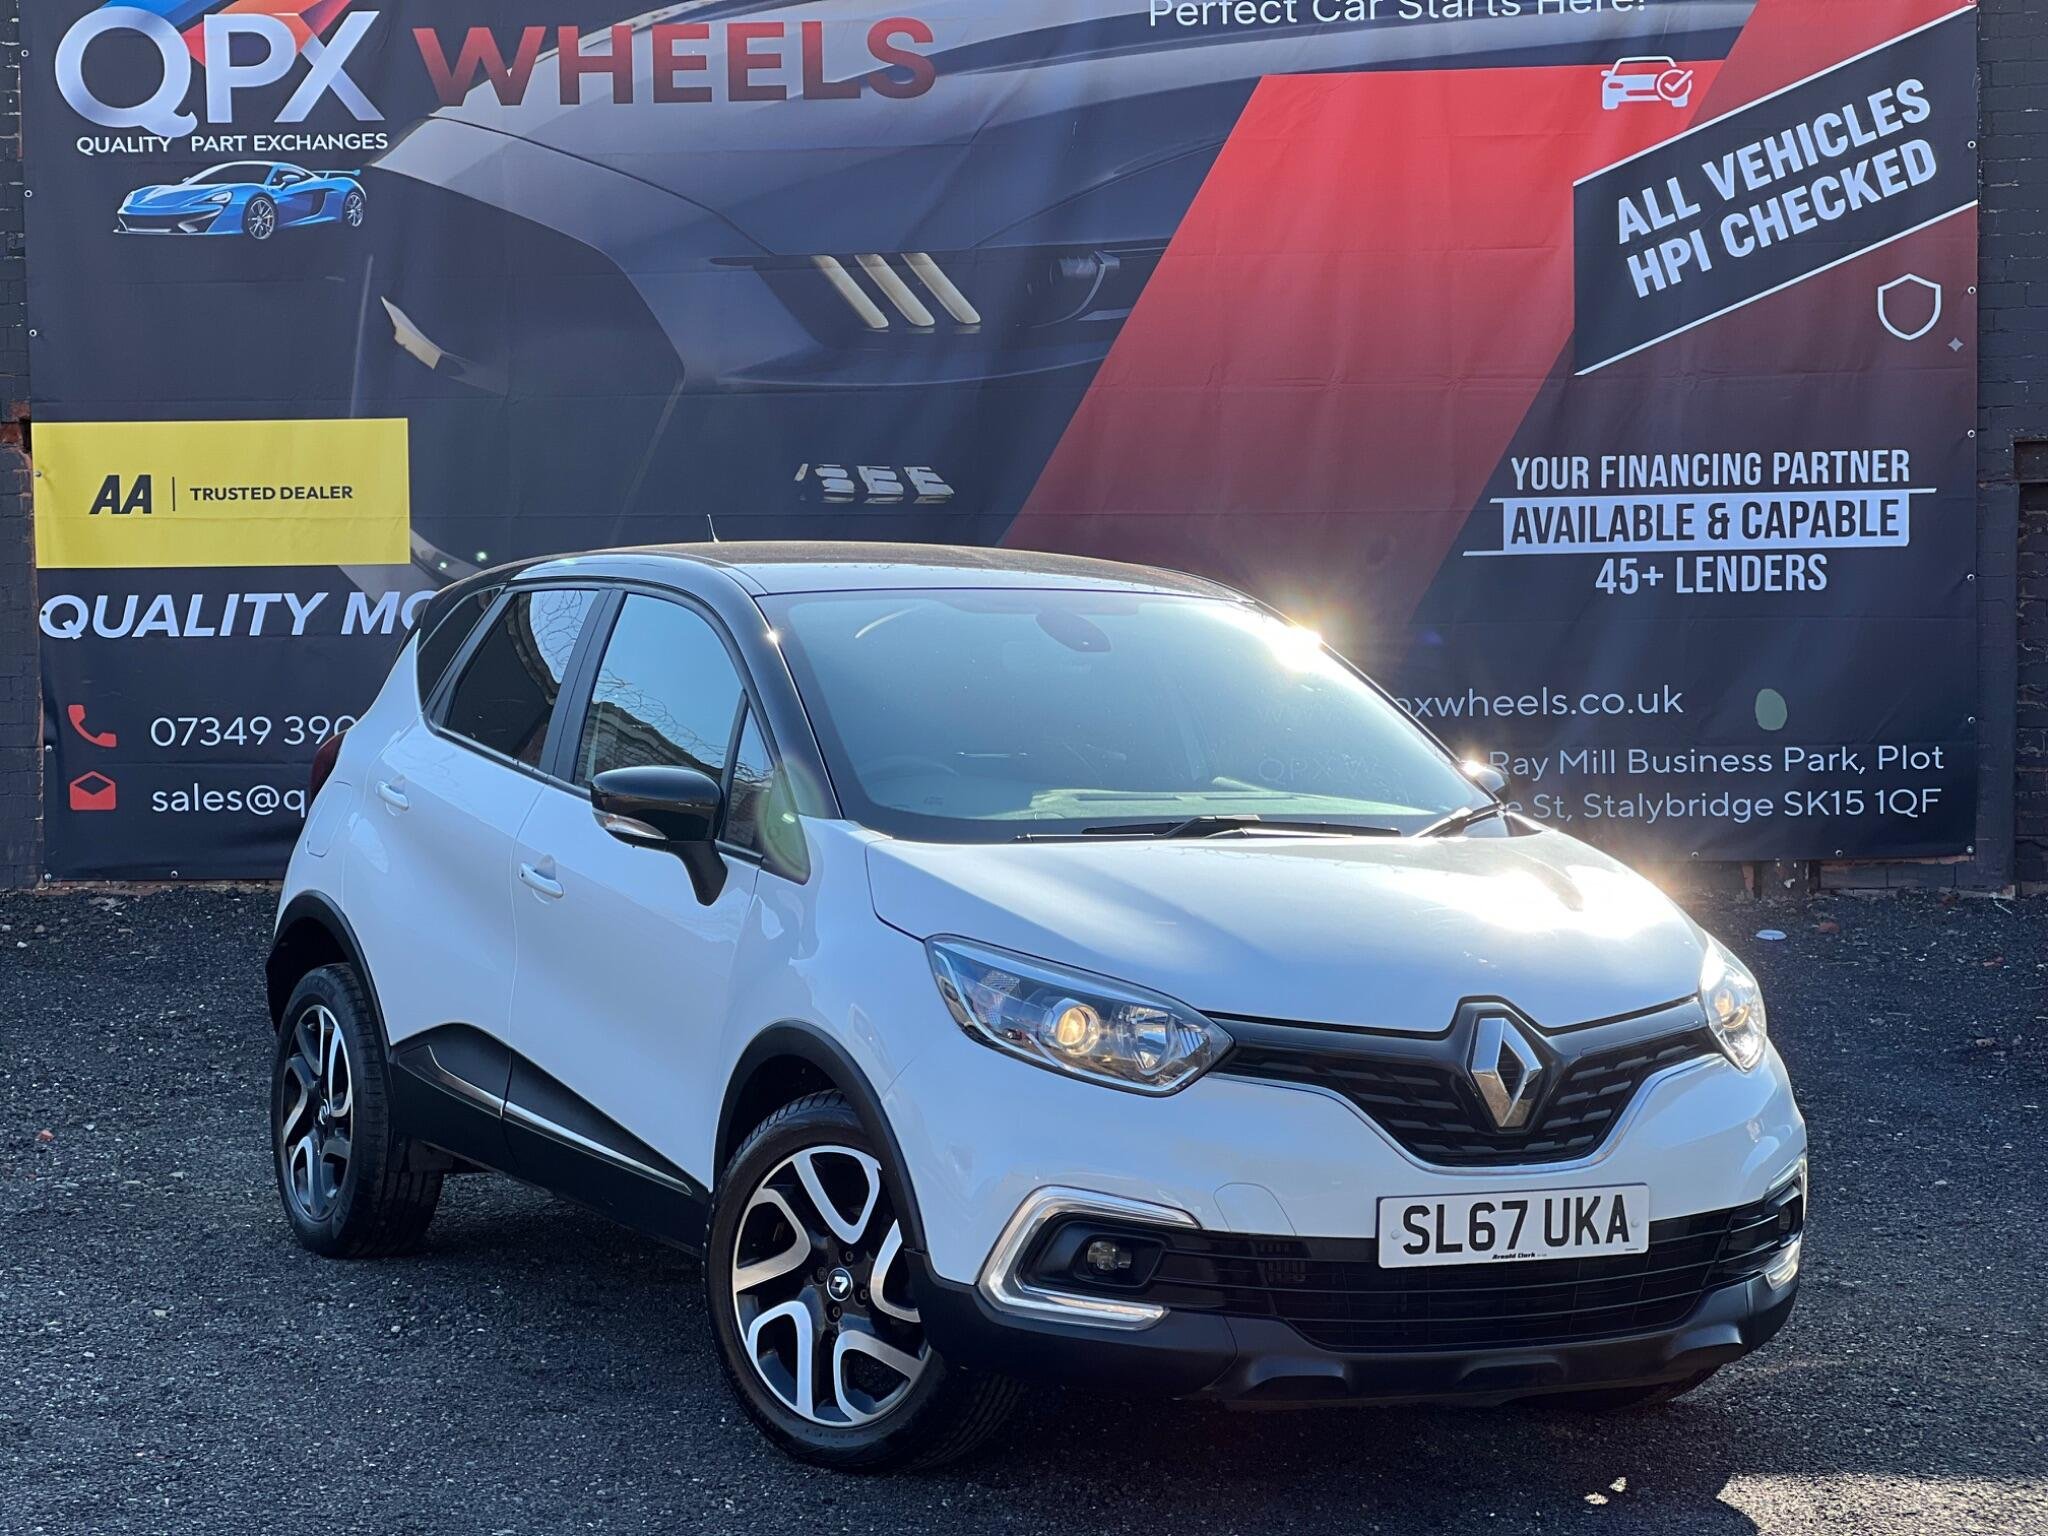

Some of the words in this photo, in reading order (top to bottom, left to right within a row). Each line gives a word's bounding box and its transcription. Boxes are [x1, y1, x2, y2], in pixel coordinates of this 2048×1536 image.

[1149, 0, 1298, 26] Perfect
[1312, 0, 1384, 22] Car
[55, 6, 386, 138] QPX
[412, 17, 936, 107] WHEELS
[76, 135, 173, 156] QUALITY
[191, 135, 247, 152] PART
[253, 133, 388, 151] EXCHANGES
[1618, 177, 1701, 245] ALL
[1702, 78, 1932, 201] VEHICLES
[1626, 228, 1713, 299] HPI
[1719, 139, 1937, 259] CHECKED
[1511, 456, 1590, 491] YOUR
[1600, 452, 1762, 489] FINANCING
[1772, 449, 1911, 485] PARTNER
[89, 474, 152, 515] AA
[190, 486, 276, 501] TRUSTED
[280, 485, 353, 500] DEALER
[1511, 502, 1695, 545] AVAILABLE
[1707, 502, 1730, 541] &
[1741, 499, 1900, 540] CAPABLE
[1595, 557, 1665, 595] 45+
[1675, 554, 1828, 594] LENDERS
[38, 591, 330, 640] QUALITY
[150, 716, 272, 747] 07349
[1489, 750, 1549, 782] Ray
[1559, 748, 1616, 775] Mill
[1628, 746, 1773, 773] Business
[1783, 745, 1866, 775] Park,
[1878, 744, 1945, 771] Plot
[1533, 793, 1573, 824] St,
[1583, 791, 1774, 824] Stalybridge
[1783, 789, 1865, 817] SK15
[1874, 787, 1942, 815] 1QF
[1402, 1199, 1529, 1255] SL67
[1544, 1194, 1631, 1248] UKA
